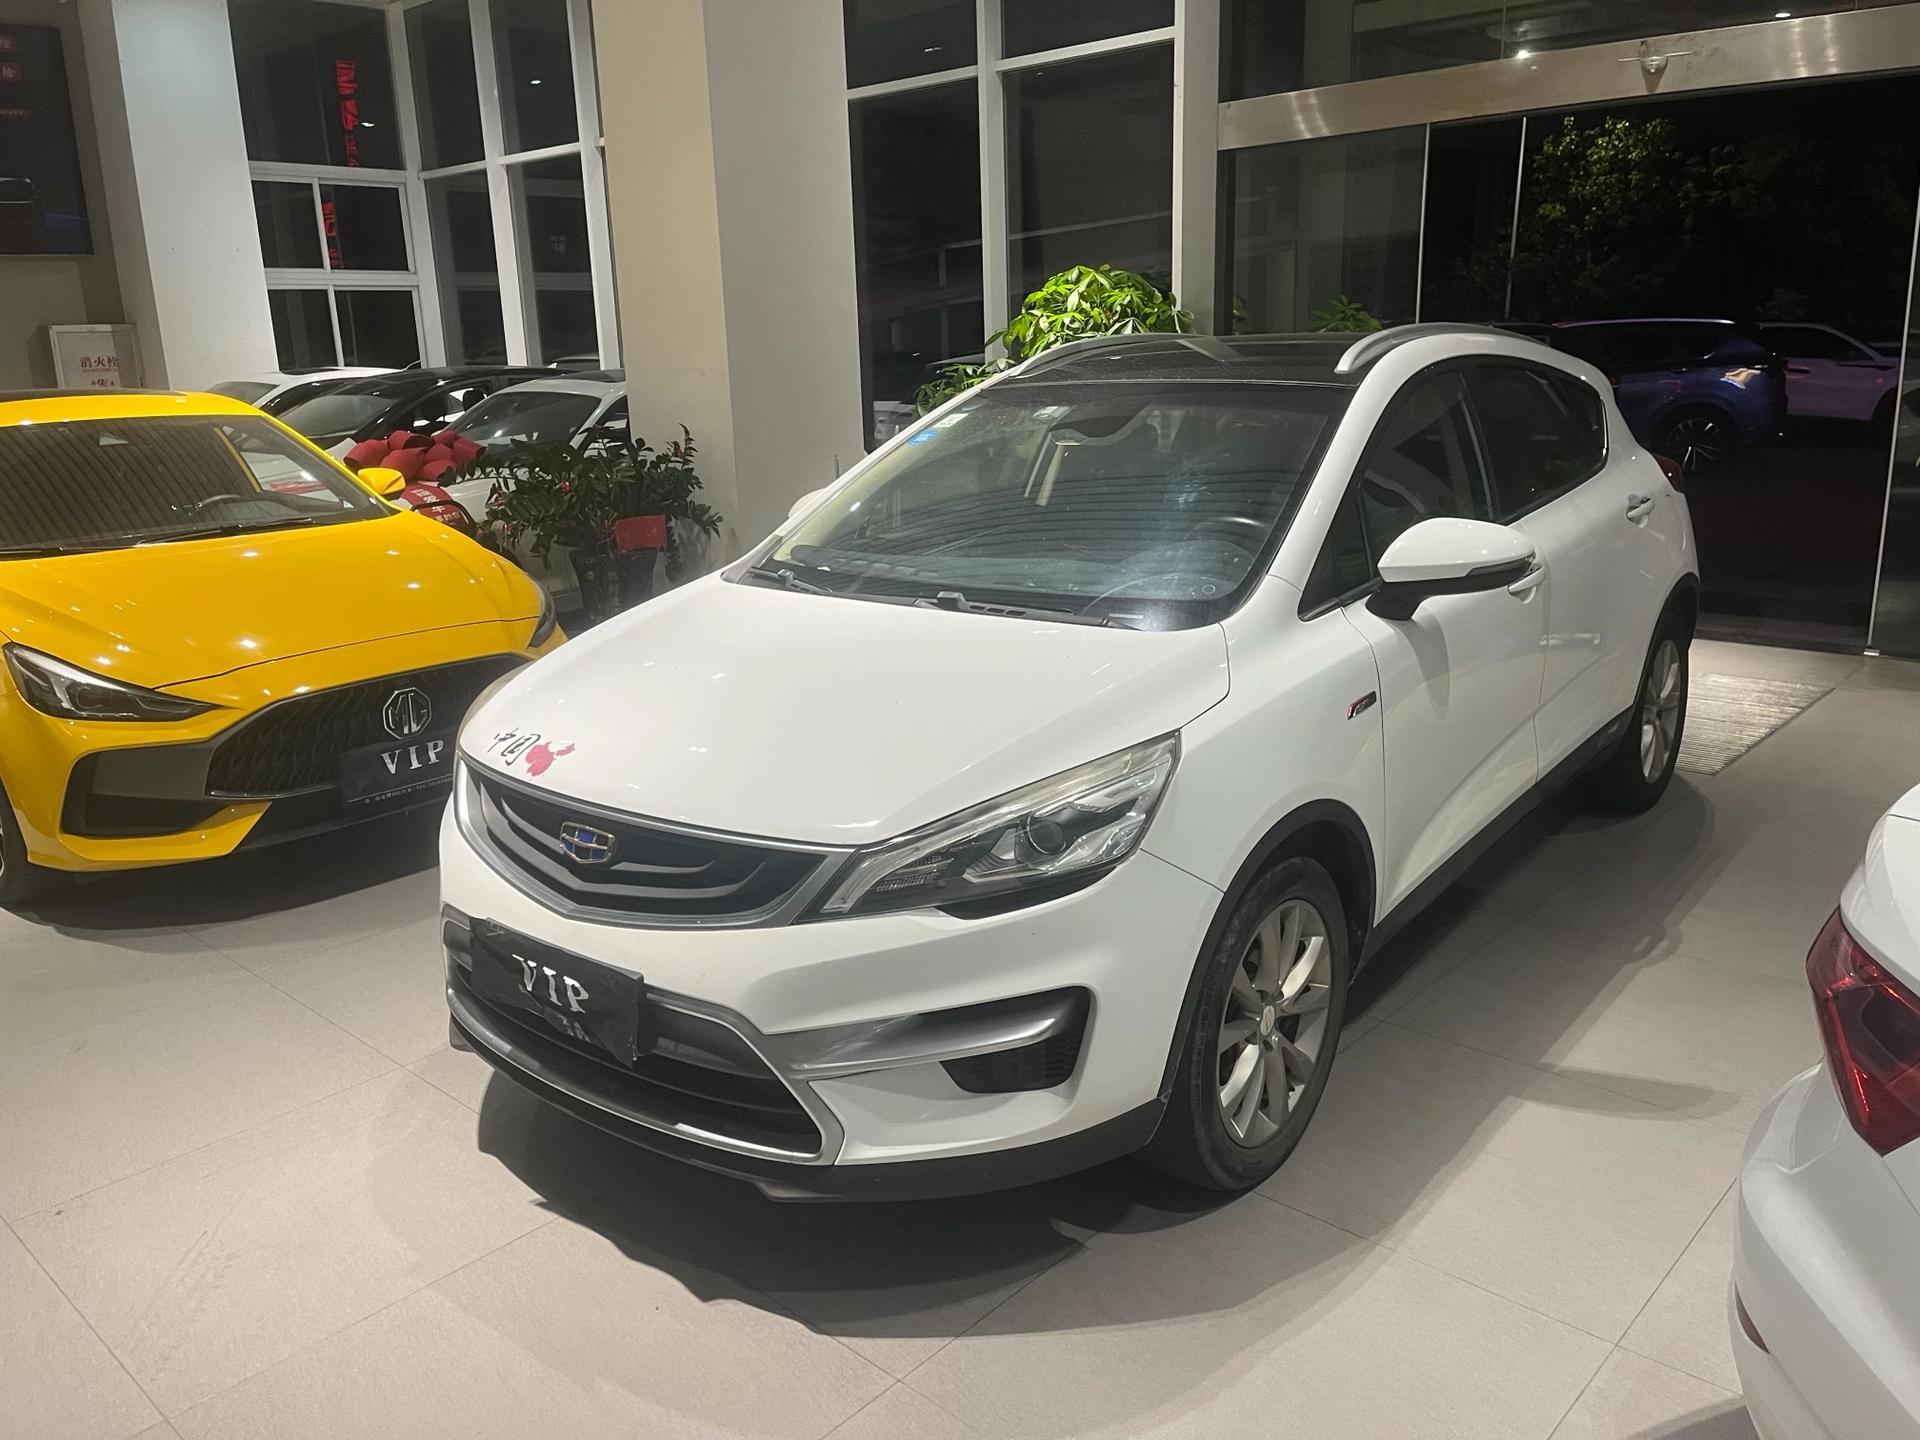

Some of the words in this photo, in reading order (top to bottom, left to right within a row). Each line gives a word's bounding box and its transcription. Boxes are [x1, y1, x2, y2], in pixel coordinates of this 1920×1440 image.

[388, 692, 428, 735] MG
[380, 740, 444, 774] VIP
[511, 953, 590, 1014] VIP
